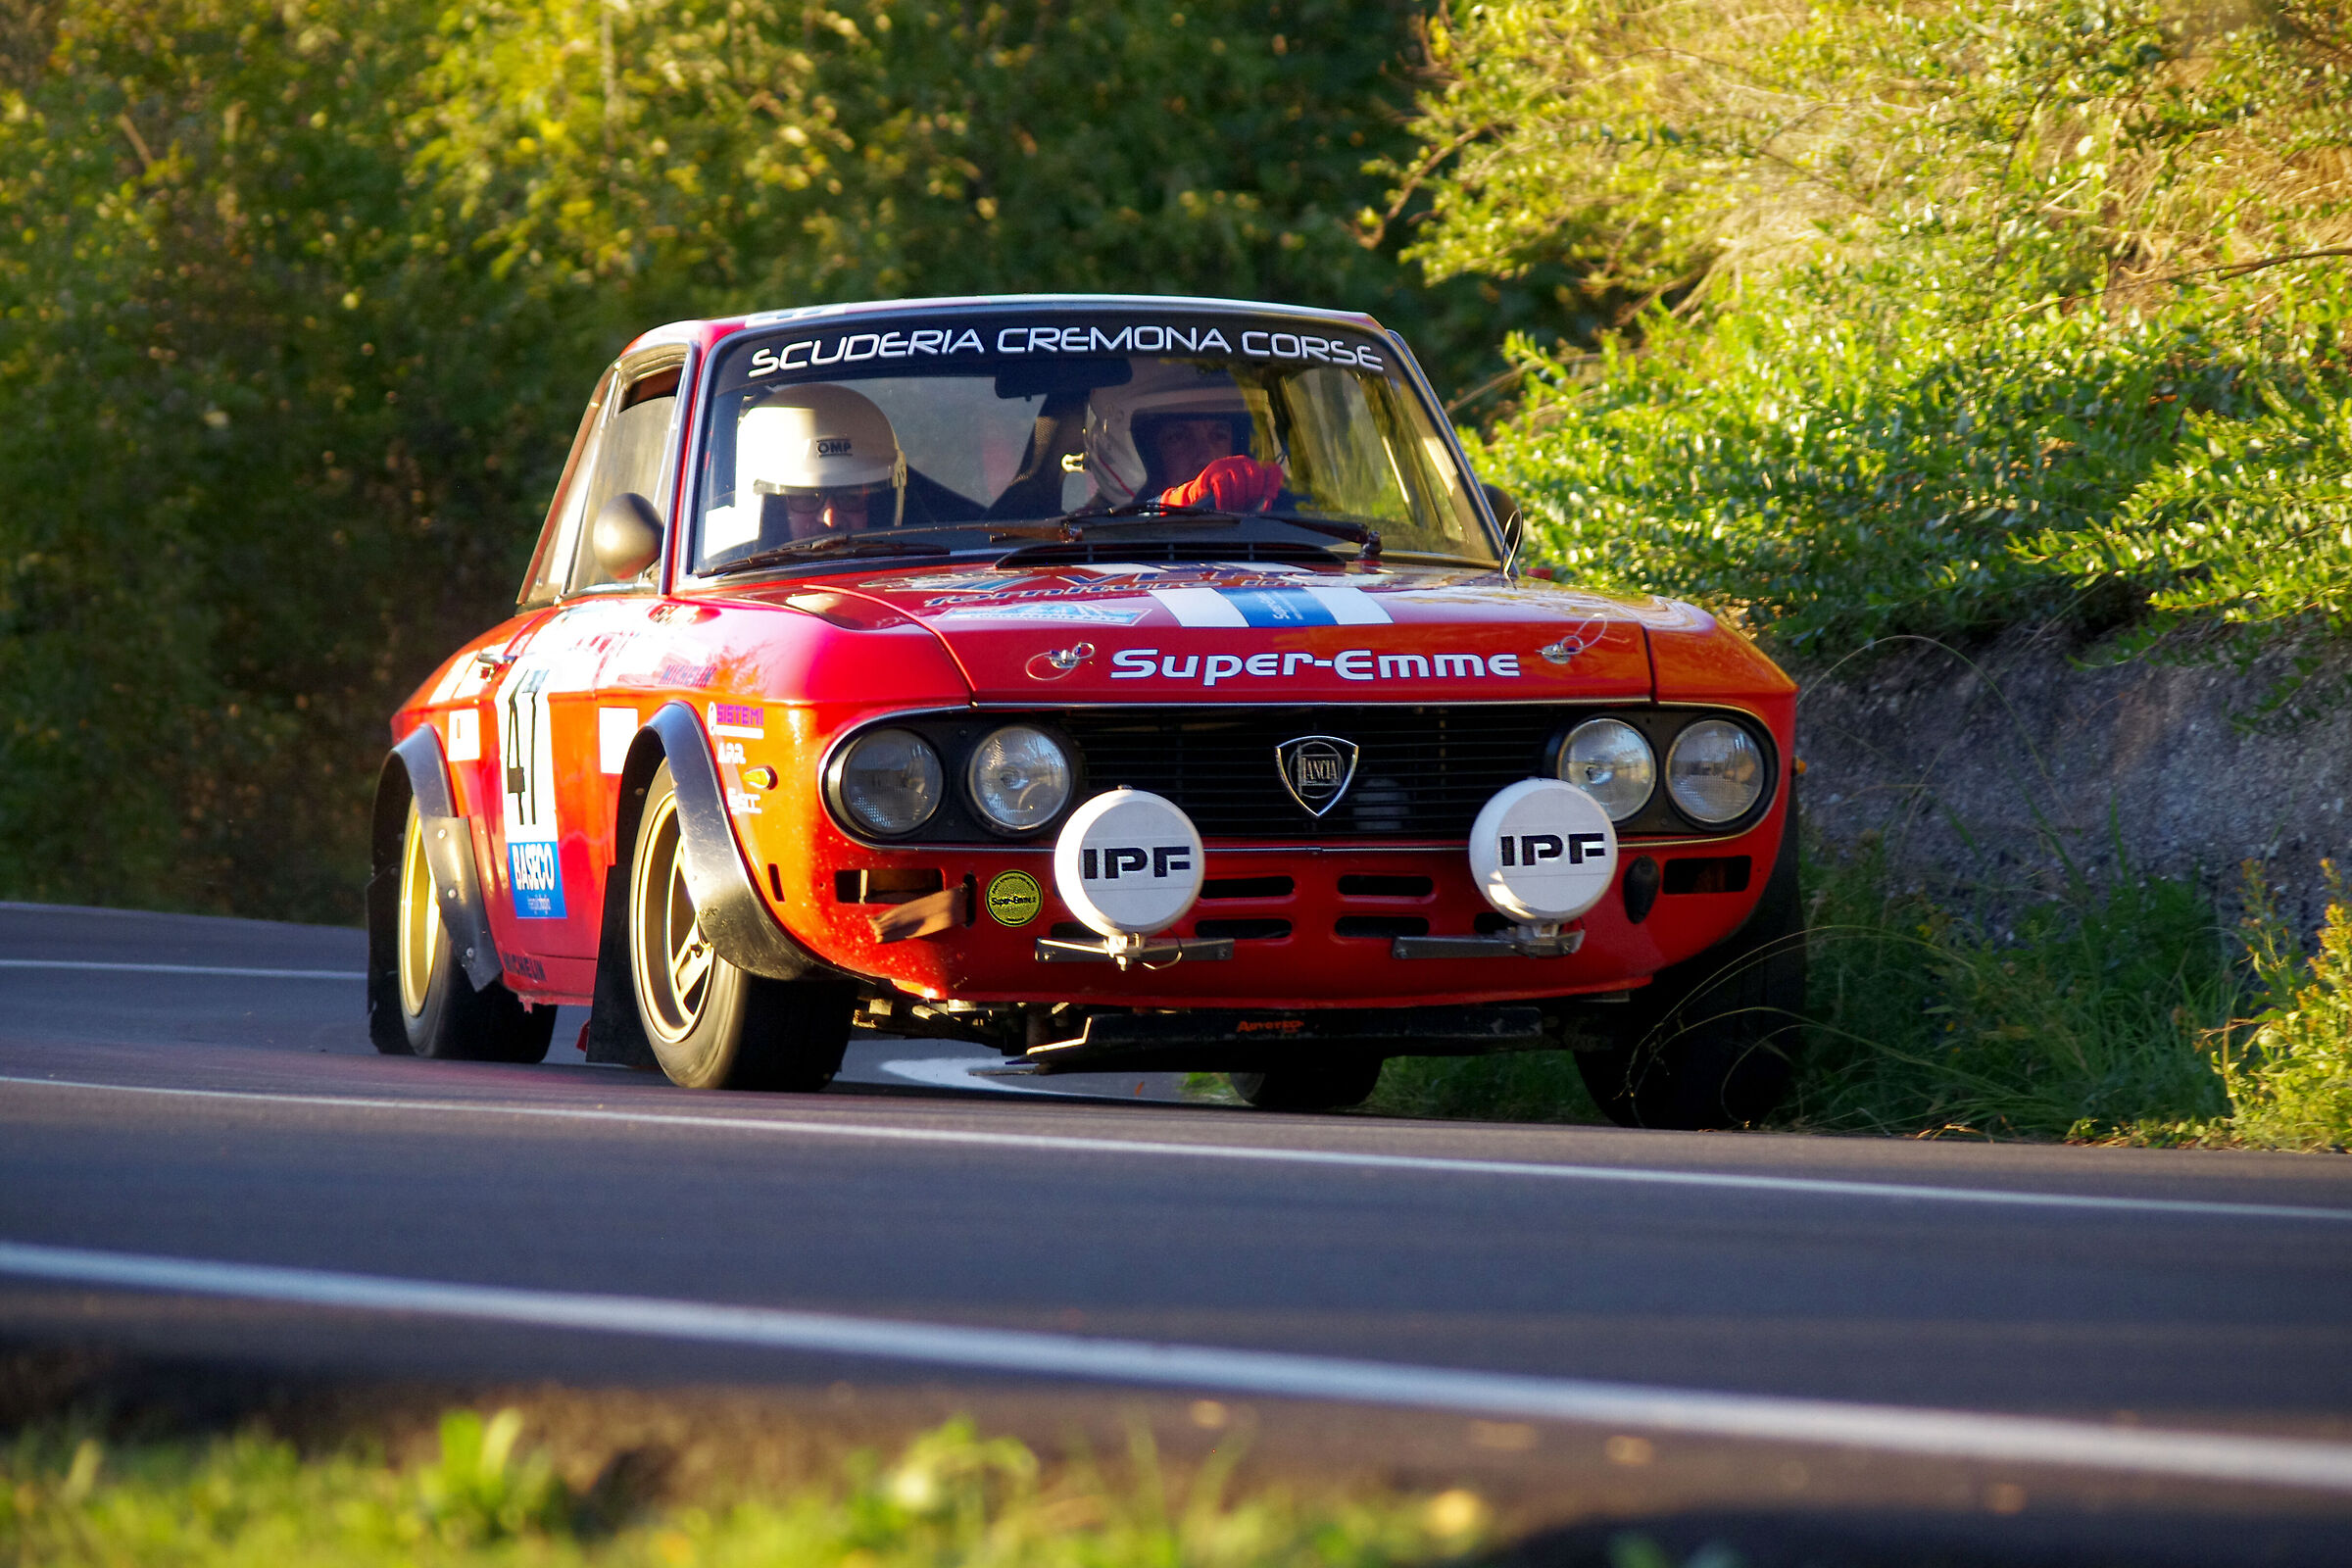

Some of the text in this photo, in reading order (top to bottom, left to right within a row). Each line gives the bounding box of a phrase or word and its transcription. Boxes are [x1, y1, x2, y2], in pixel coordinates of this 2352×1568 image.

[748, 325, 1384, 378] SCUDERIA CREMONA CORSE
[817, 441, 852, 453] OMP
[659, 664, 717, 688] MICHELIN
[1110, 648, 1522, 686] Super-Emme
[716, 704, 763, 726] SISTEMI
[507, 668, 550, 825] 47
[1301, 757, 1338, 781] LANCIA
[512, 843, 556, 891] BASECO
[1083, 846, 1192, 880] IPF
[1500, 832, 1606, 868] IPF
